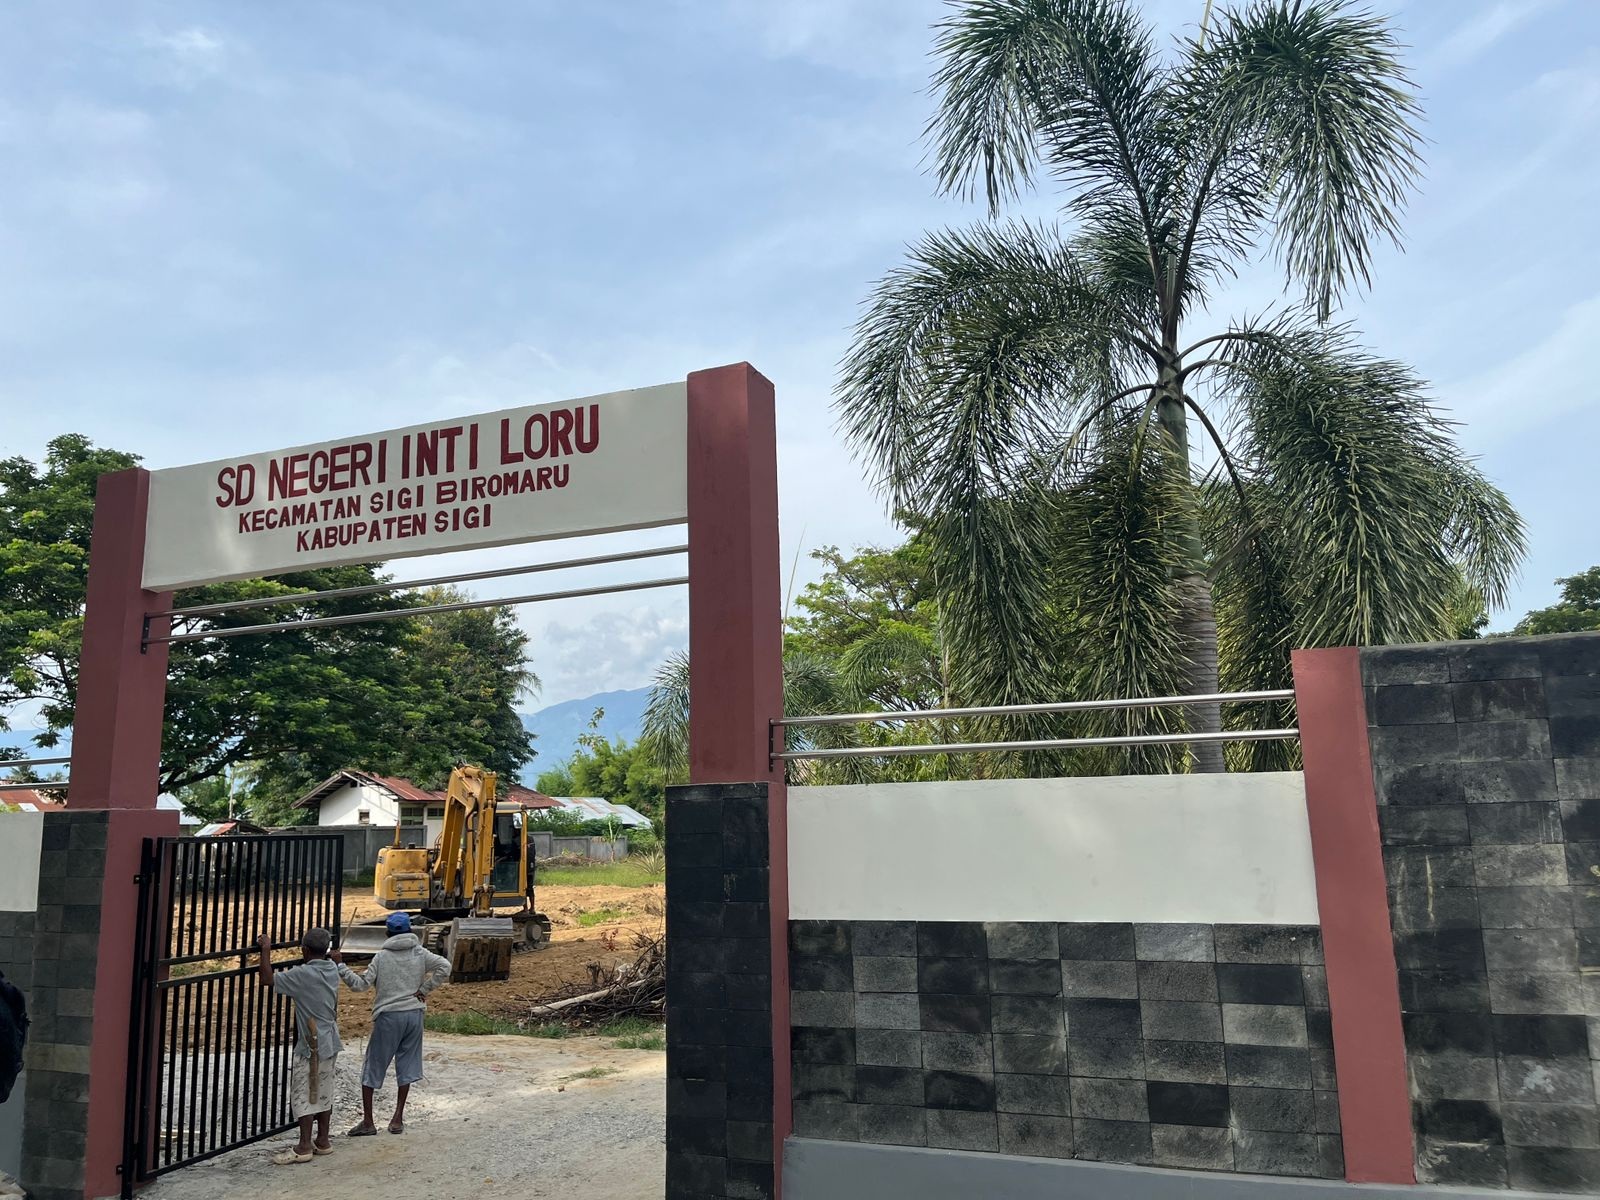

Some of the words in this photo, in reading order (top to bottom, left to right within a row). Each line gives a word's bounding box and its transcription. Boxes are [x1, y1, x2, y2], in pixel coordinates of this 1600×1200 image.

[216, 464, 255, 508] SD
[268, 439, 387, 501] NEGERI
[401, 423, 478, 479] INTI
[501, 404, 599, 465] LORU
[239, 495, 361, 533] KECAMATAN
[370, 485, 424, 513] SIGI
[436, 464, 569, 503] BIROMARU
[297, 512, 426, 552] KABUPATEN
[434, 504, 491, 532] SIGI
